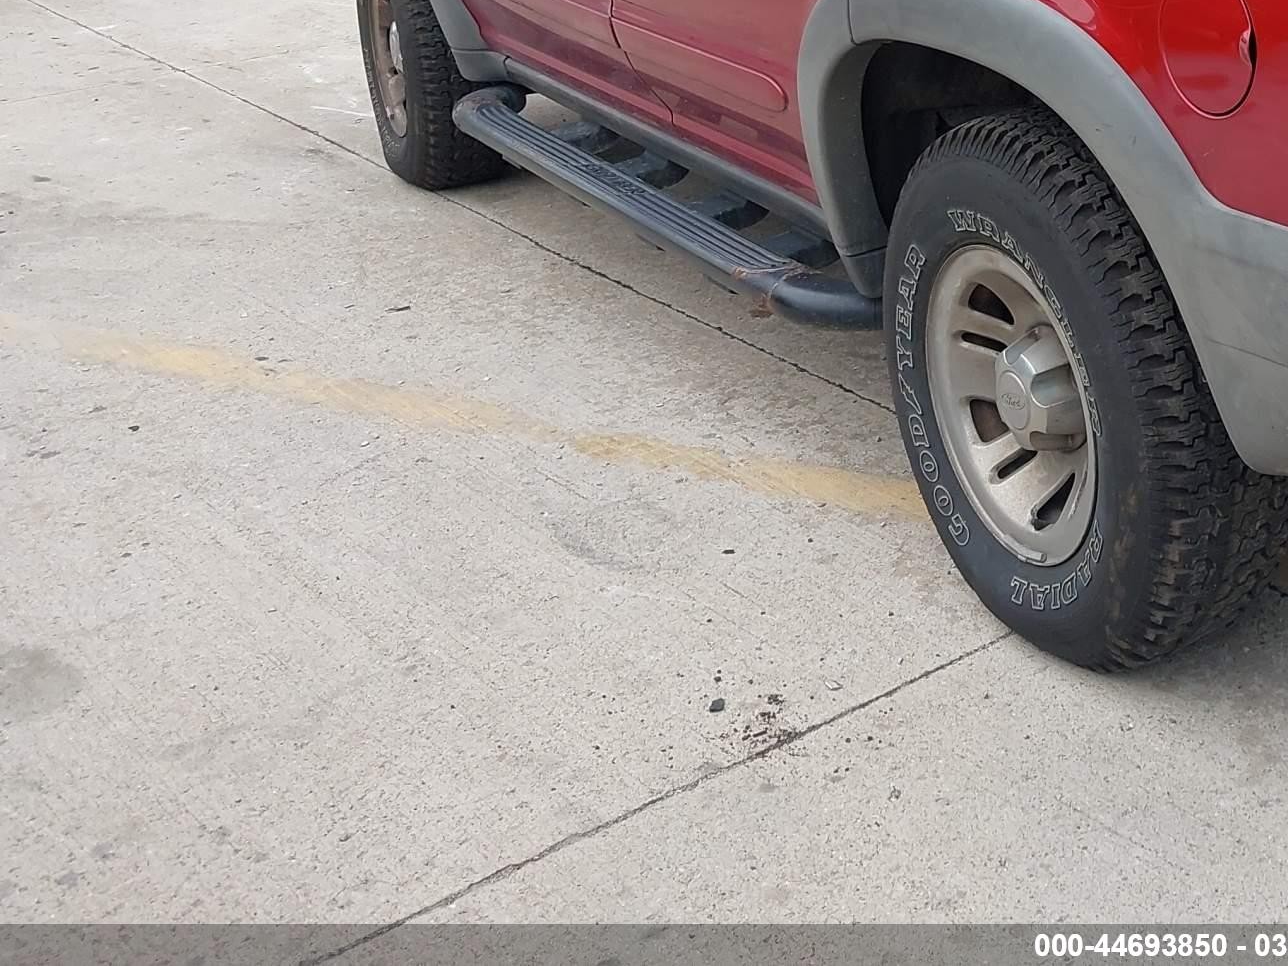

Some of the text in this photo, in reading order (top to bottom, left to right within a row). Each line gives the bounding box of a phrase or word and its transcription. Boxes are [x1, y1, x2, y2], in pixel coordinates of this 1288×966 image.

[896, 244, 970, 547] GOODYEAR
[948, 209, 1102, 436] WRANGLER
[1010, 519, 1103, 611] RADIAL
